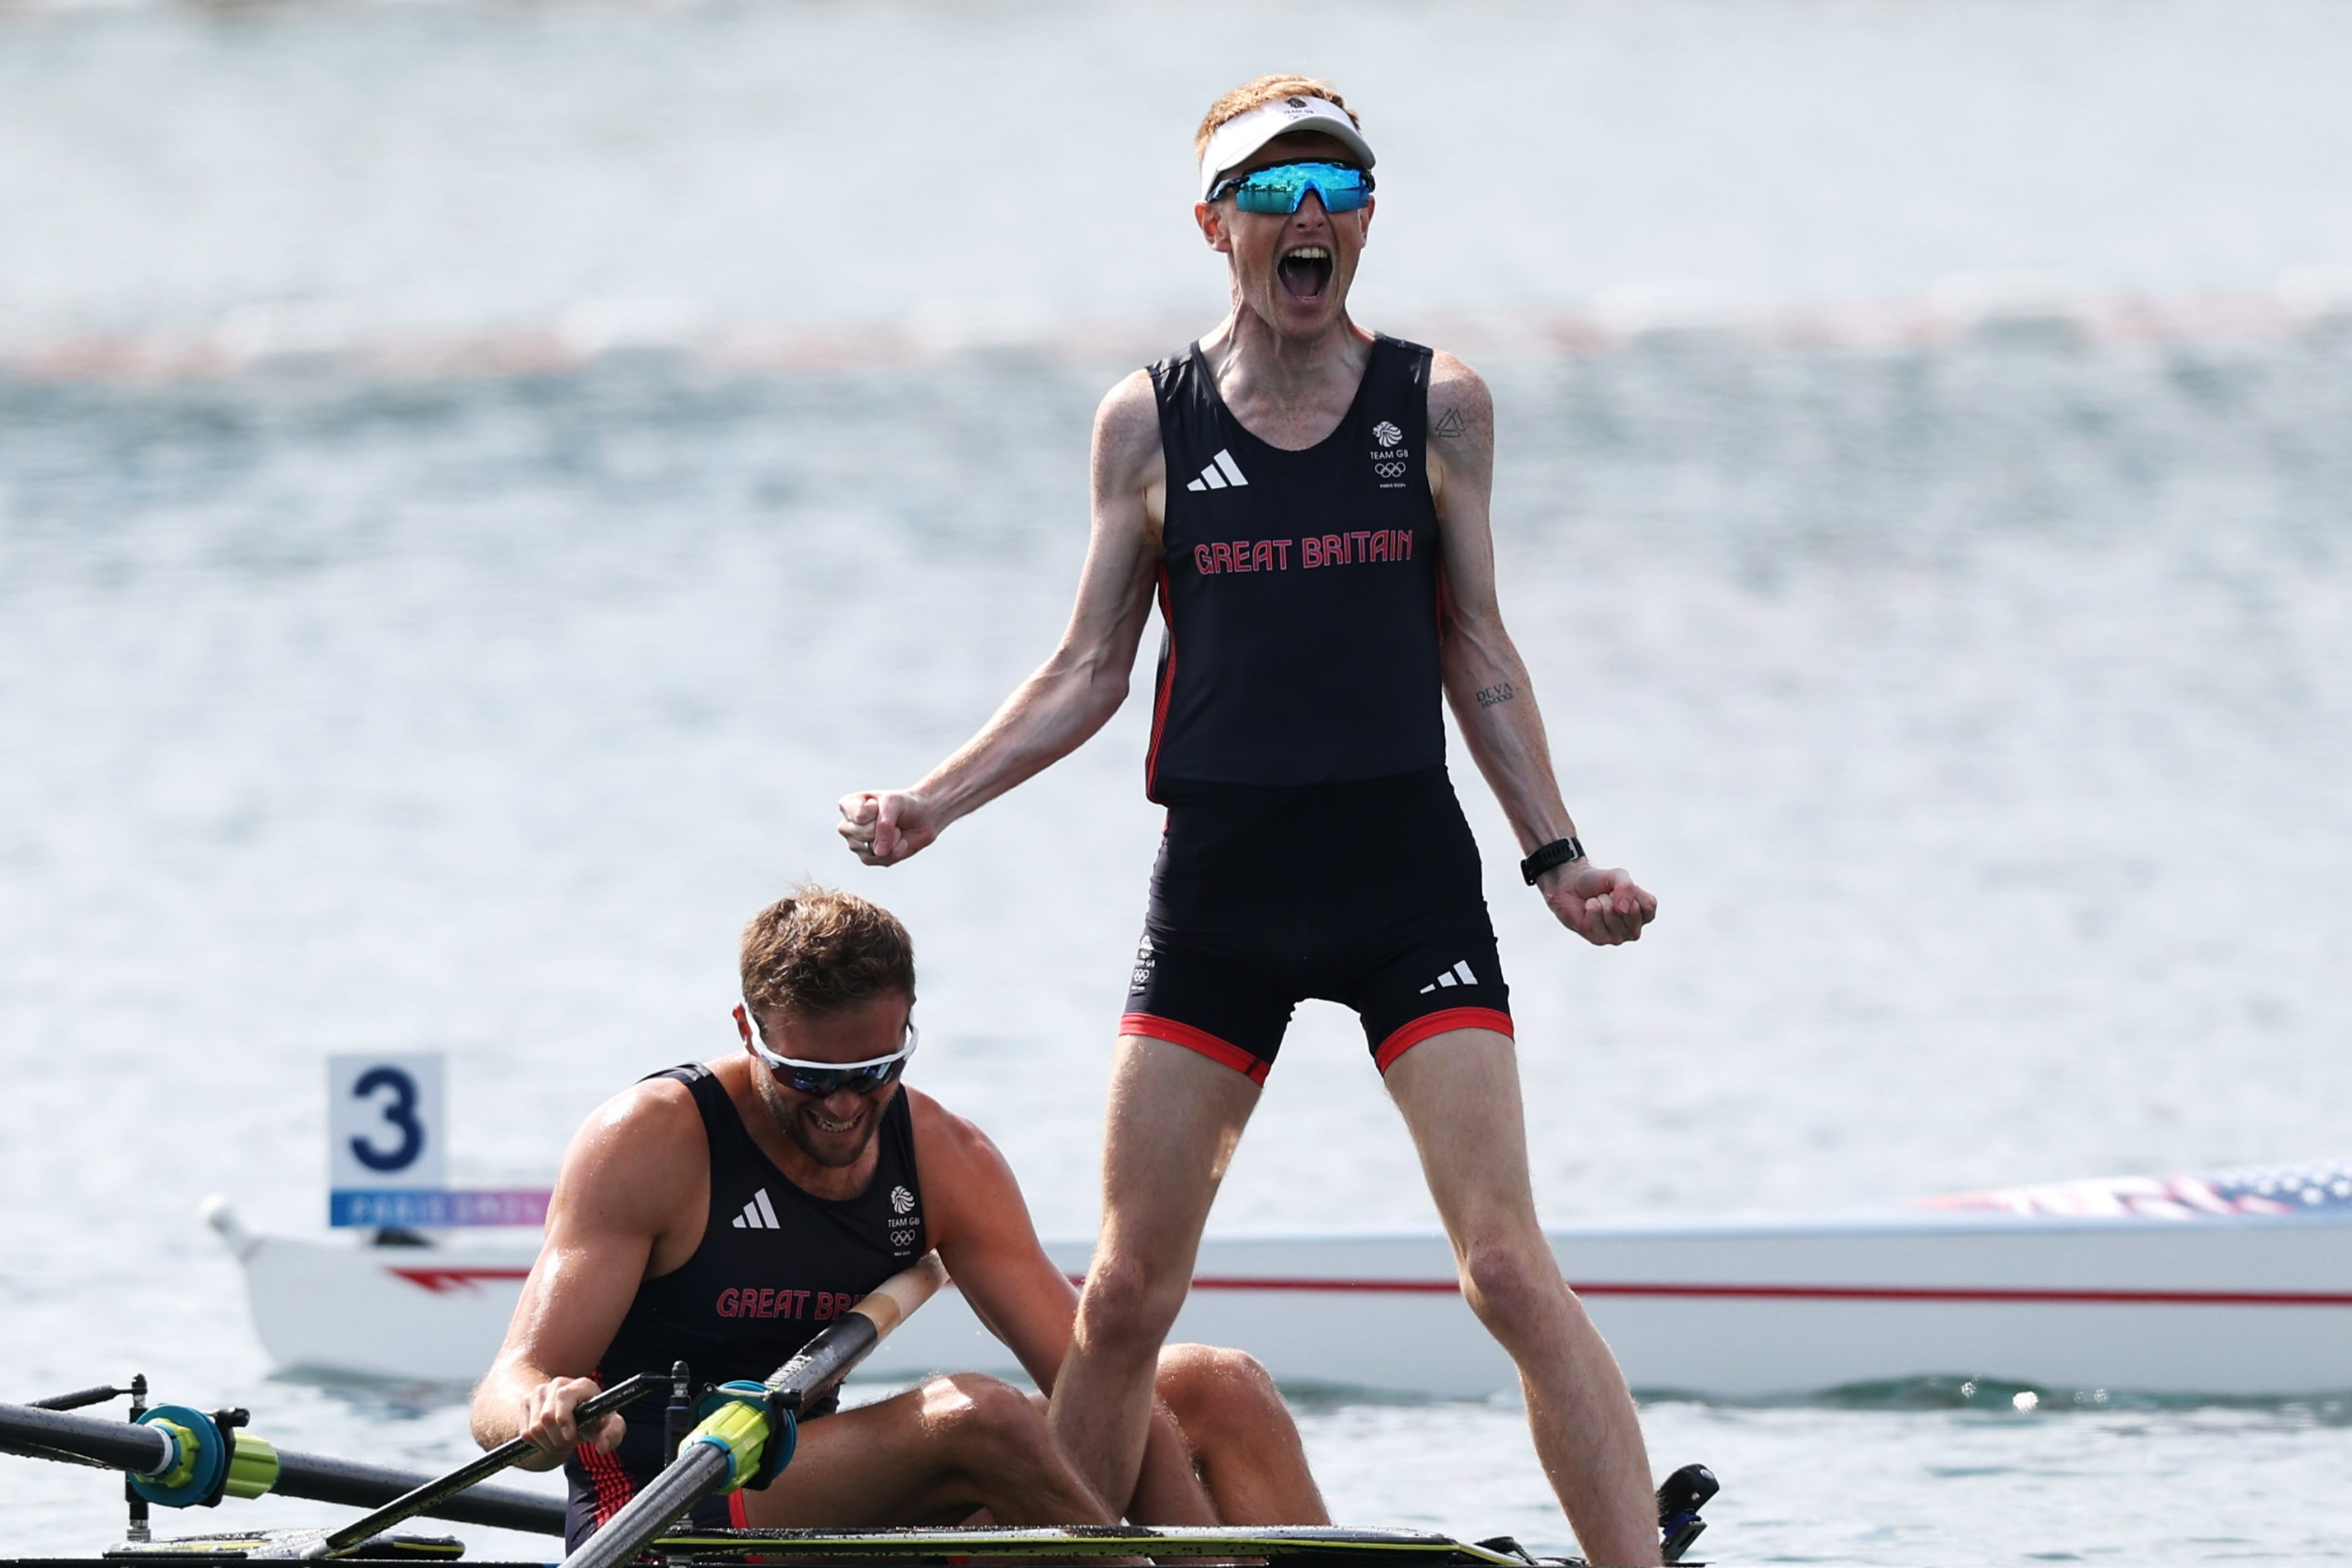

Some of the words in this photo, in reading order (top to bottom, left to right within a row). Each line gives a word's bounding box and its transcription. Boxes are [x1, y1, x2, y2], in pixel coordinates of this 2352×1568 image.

[1369, 450, 1394, 460] TEAM
[1396, 448, 1409, 458] GB
[1194, 540, 1293, 575] GREAT
[1303, 529, 1413, 569] BRITAIN
[1476, 683, 1513, 702] DEVA
[349, 1065, 425, 1175] 3
[888, 1218, 908, 1228] TEAM
[908, 1216, 921, 1226] GB
[716, 1288, 811, 1319] GREAT
[814, 1291, 866, 1321] BR
